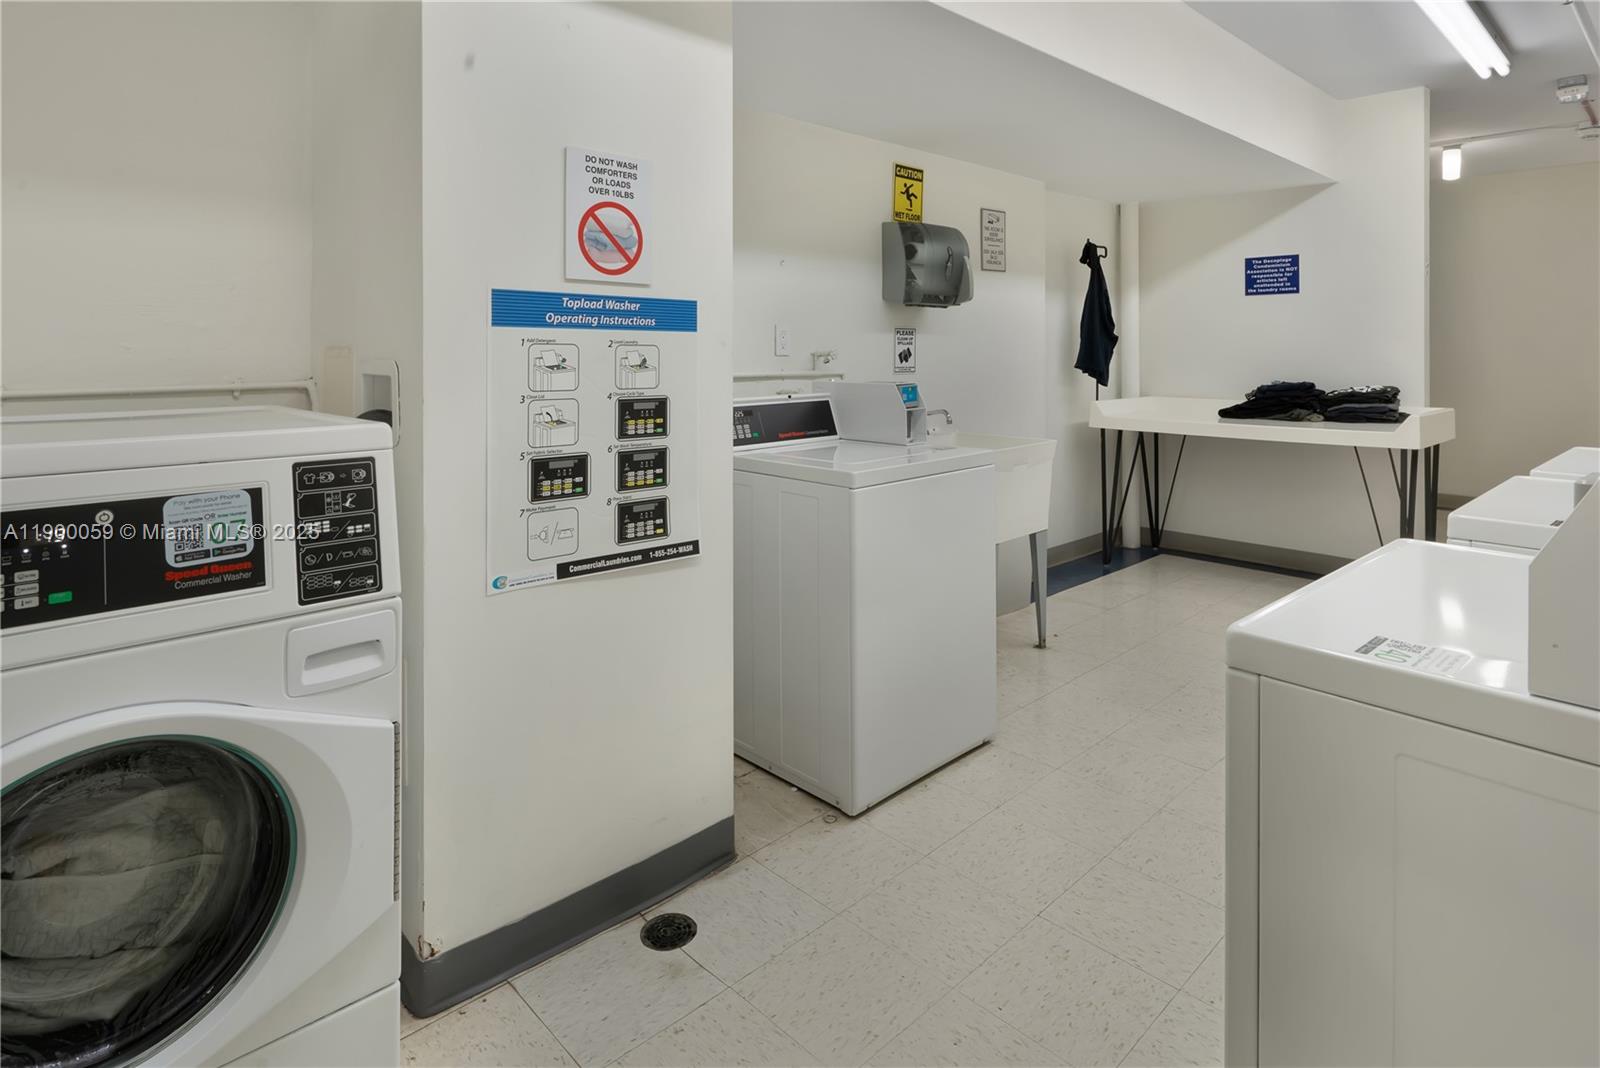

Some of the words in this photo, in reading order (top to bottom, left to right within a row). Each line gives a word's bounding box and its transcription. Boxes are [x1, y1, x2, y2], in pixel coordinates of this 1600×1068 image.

[585, 155, 597, 164] DO
[598, 157, 614, 167] NOT
[616, 160, 638, 170] WASH
[585, 166, 637, 181] COMFORTERS
[896, 166, 922, 180] CAUTION
[592, 177, 603, 185] OR
[606, 178, 631, 189] LOADS
[588, 186, 610, 196] OVER
[612, 190, 634, 200] 10LBS
[905, 213, 921, 221] FLOOR
[562, 297, 604, 311] Topload
[605, 299, 640, 311] Washer
[545, 312, 598, 326] Operating
[600, 313, 656, 326] Instructions
[521, 338, 526, 347] 1
[608, 340, 613, 348] 2
[520, 395, 525, 403] 3
[607, 392, 612, 400] 4
[608, 445, 613, 453] 6
[520, 452, 525, 460] 5
[606, 497, 612, 506] 8
[204, 512, 216, 520] OR
[520, 509, 525, 518] 7
[210, 519, 246, 544] 07
[569, 554, 642, 573] CommercialLaundries.com
[165, 566, 209, 582] Speed
[211, 561, 253, 575] Queen
[174, 574, 222, 589] Commercial
[222, 571, 253, 583] Washer
